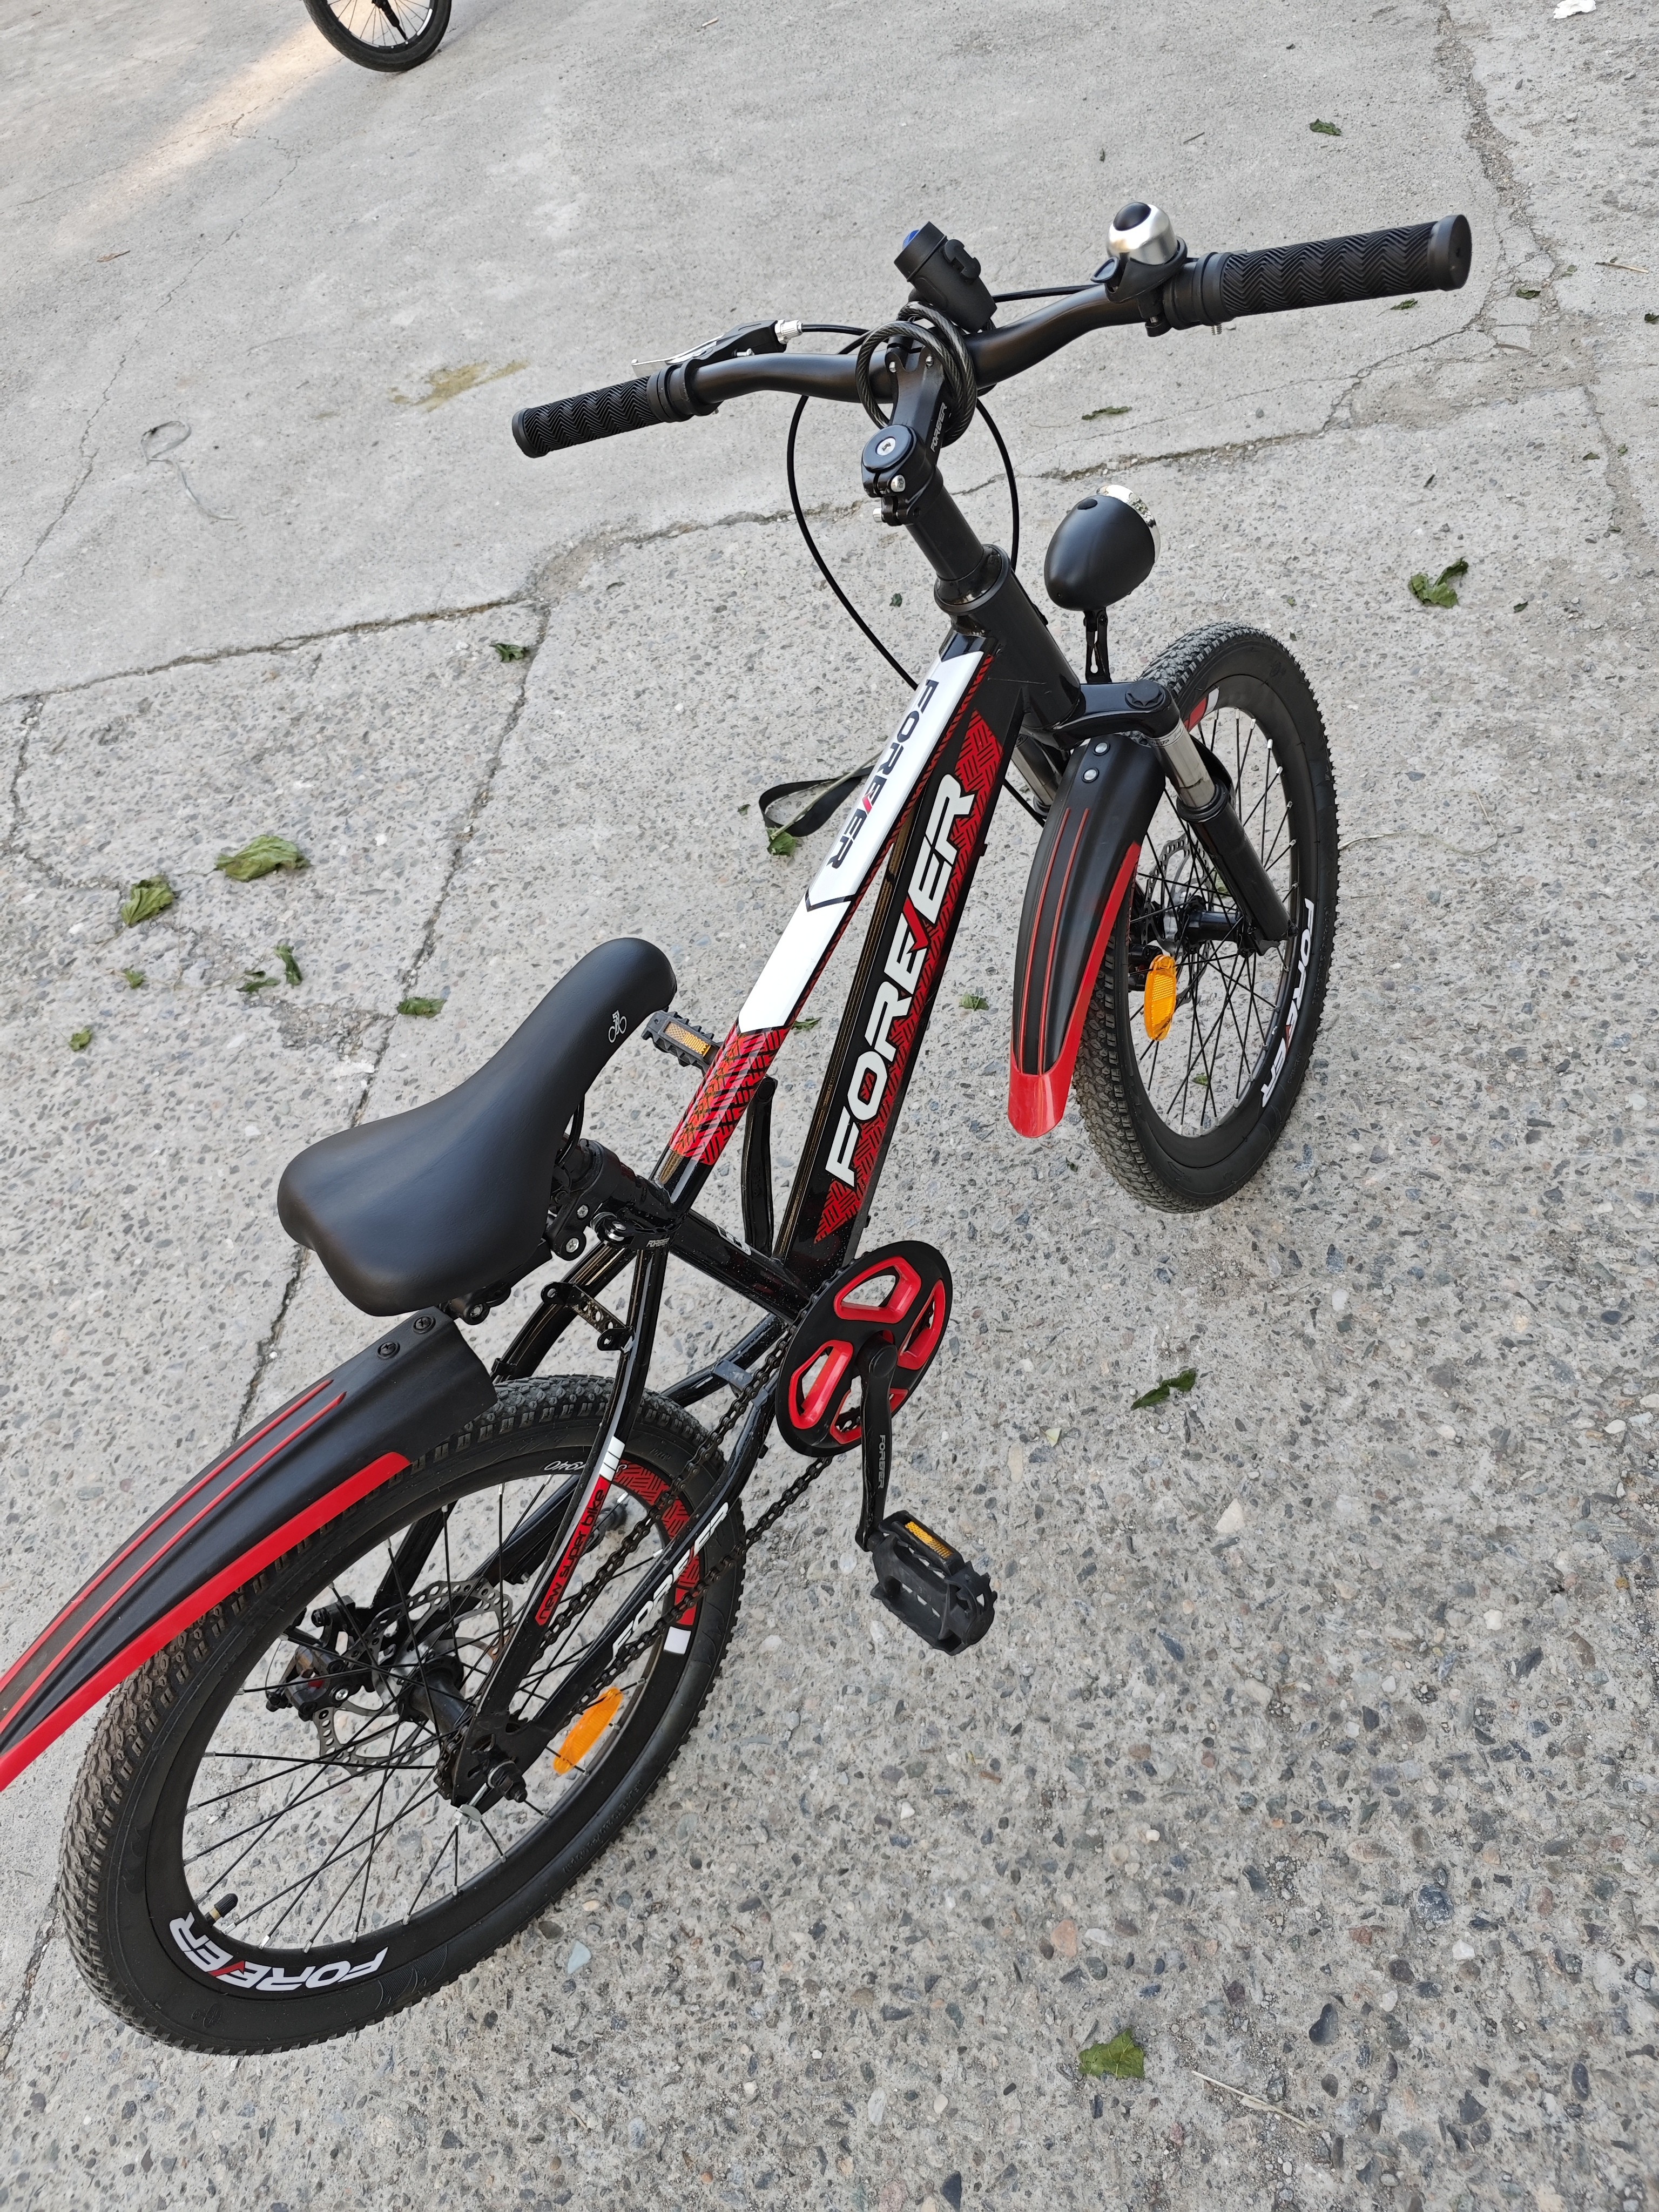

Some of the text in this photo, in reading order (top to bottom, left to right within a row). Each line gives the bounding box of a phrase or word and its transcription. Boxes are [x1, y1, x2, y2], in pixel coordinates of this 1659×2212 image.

[930, 402, 947, 453] FOREVER
[826, 678, 939, 869] FOREVER
[825, 773, 976, 1188] FOREVER
[538, 1489, 605, 1620] new super bike
[169, 1911, 389, 1992] FOREVER
